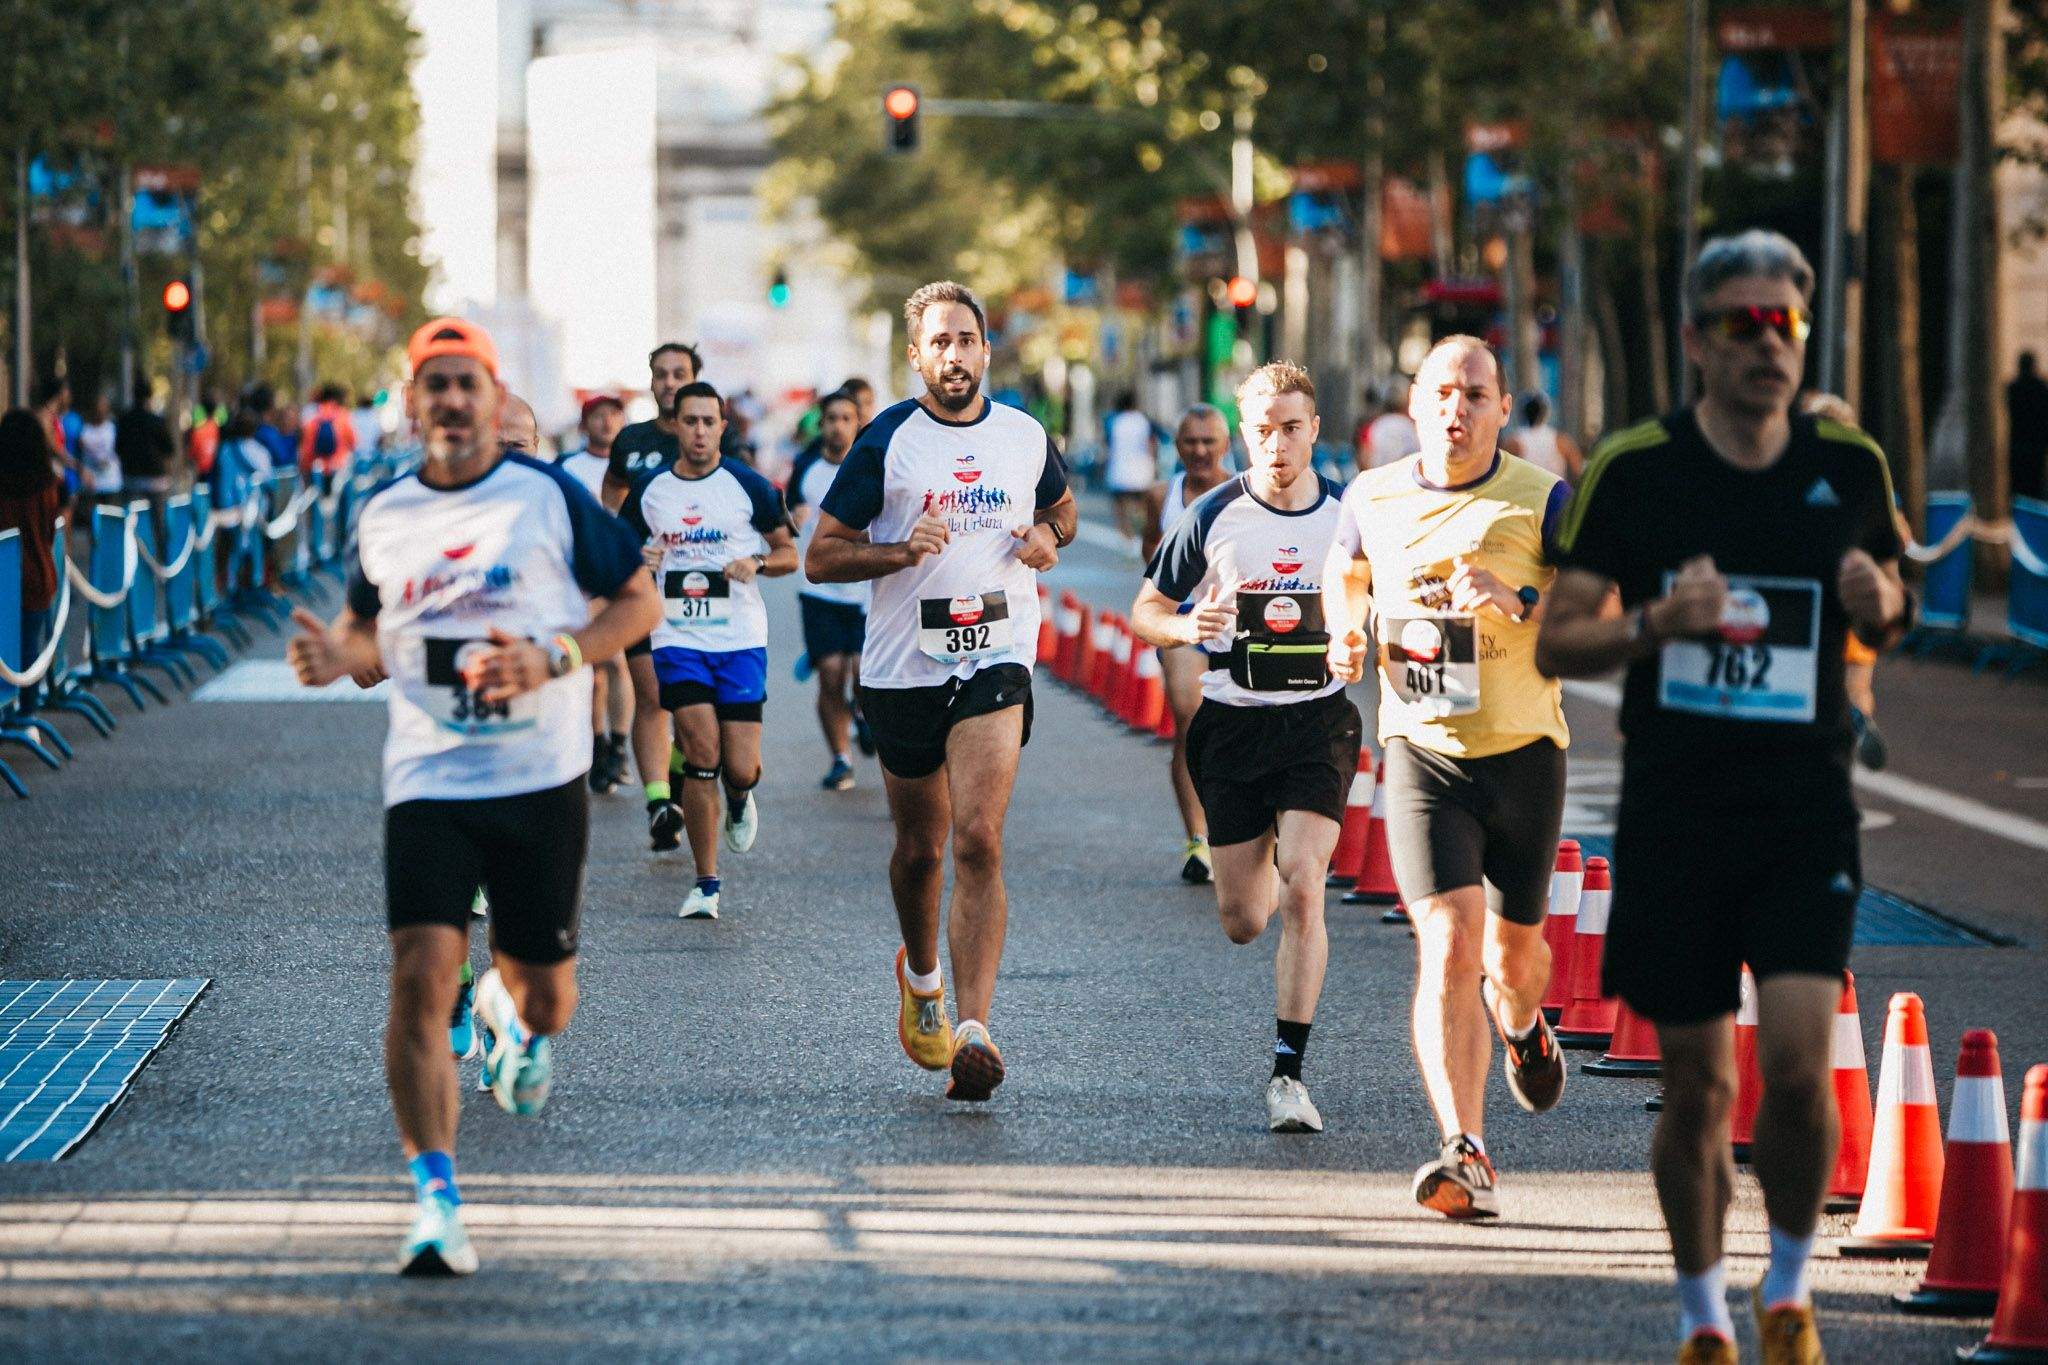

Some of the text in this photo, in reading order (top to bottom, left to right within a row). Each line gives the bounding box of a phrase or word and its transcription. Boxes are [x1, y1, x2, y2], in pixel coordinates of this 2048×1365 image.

[684, 598, 711, 618] 371
[946, 626, 991, 653] 392
[1479, 648, 1507, 661] sion
[1706, 644, 1773, 689] 762
[1406, 667, 1447, 694] 401
